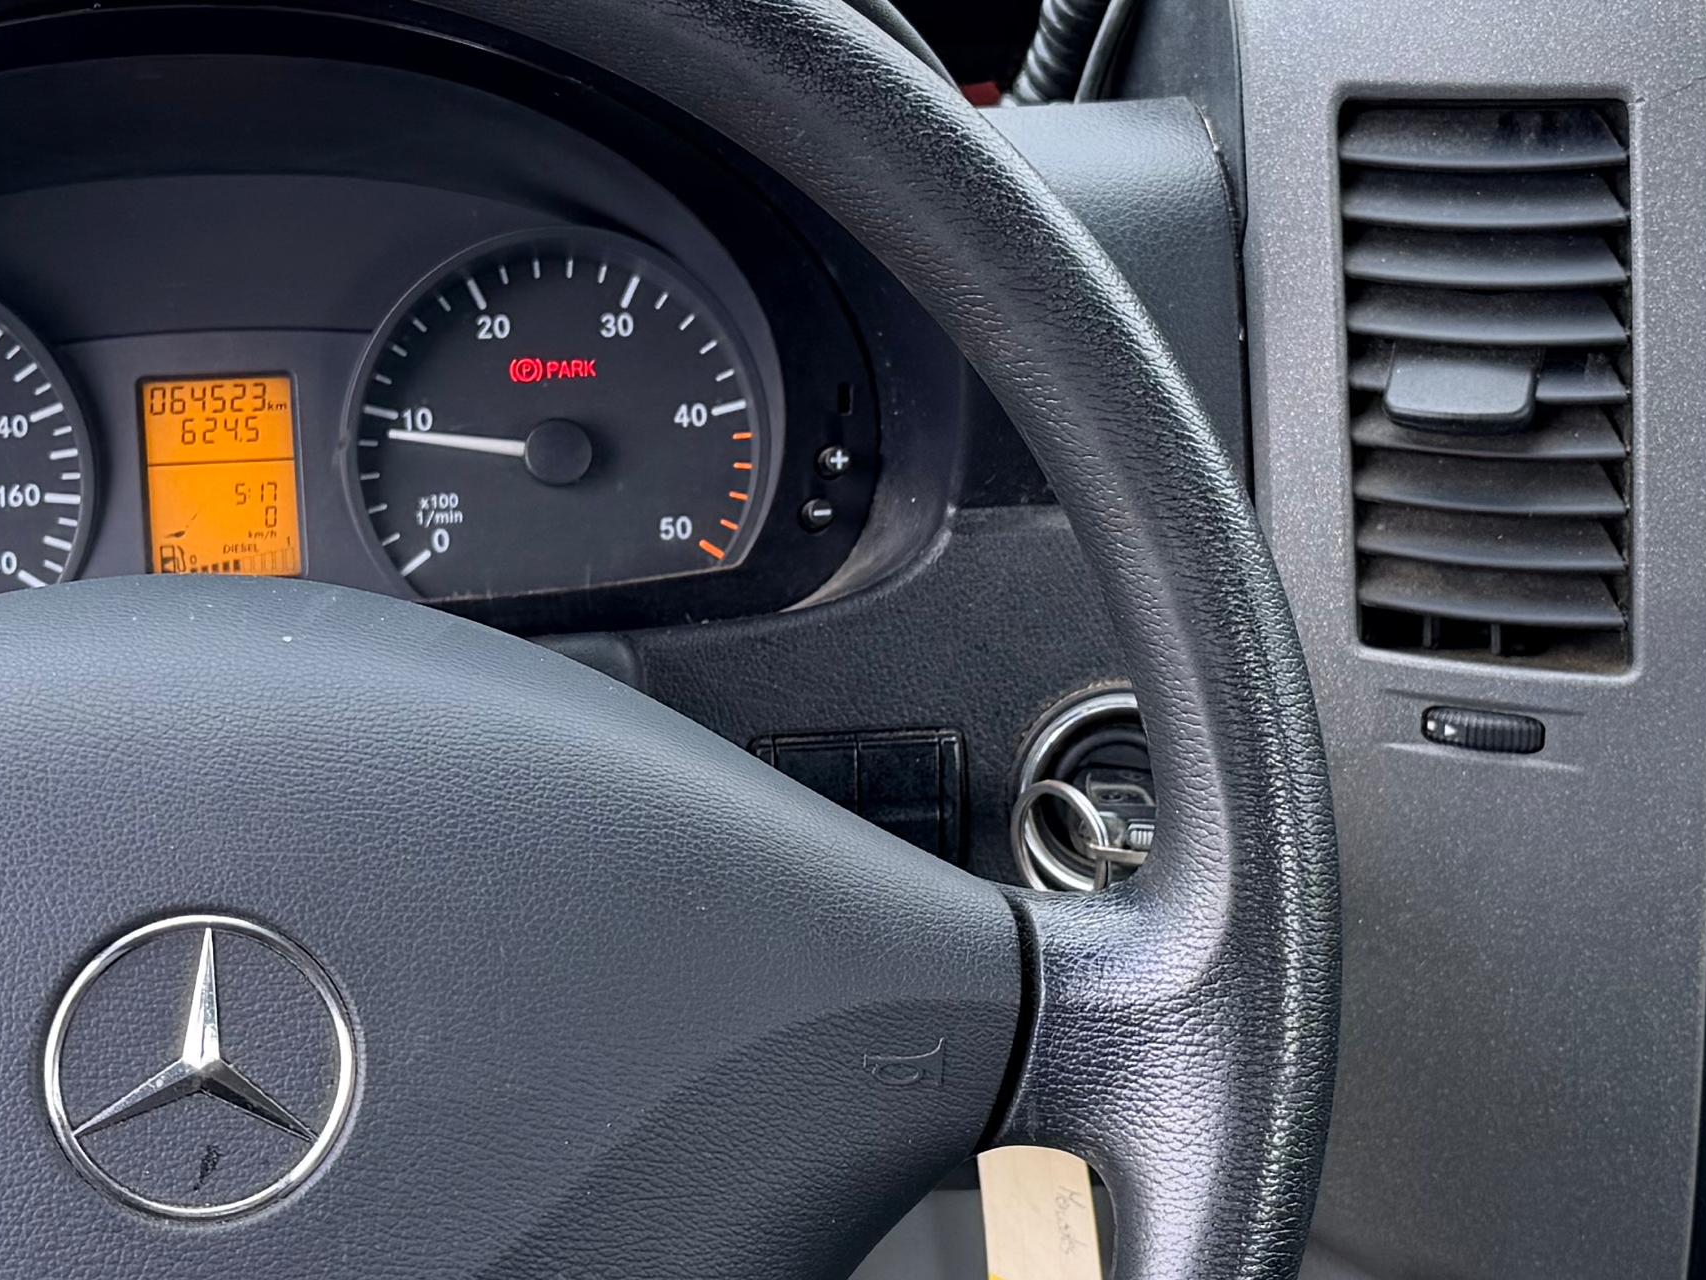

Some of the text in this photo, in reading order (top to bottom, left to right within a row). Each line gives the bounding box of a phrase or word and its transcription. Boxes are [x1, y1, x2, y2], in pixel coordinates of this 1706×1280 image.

[477, 315, 511, 340] 20
[600, 313, 634, 338] 30
[546, 359, 596, 379] PARK
[149, 382, 287, 416] 064523 km
[402, 408, 433, 432] 10
[674, 403, 708, 428] 40
[419, 493, 459, 509] x100
[264, 505, 278, 529] 0
[416, 509, 463, 528] 1/min
[659, 515, 693, 541] 50
[248, 529, 278, 541] km/h
[432, 528, 450, 553] 0
[223, 543, 260, 556] DIESEL
